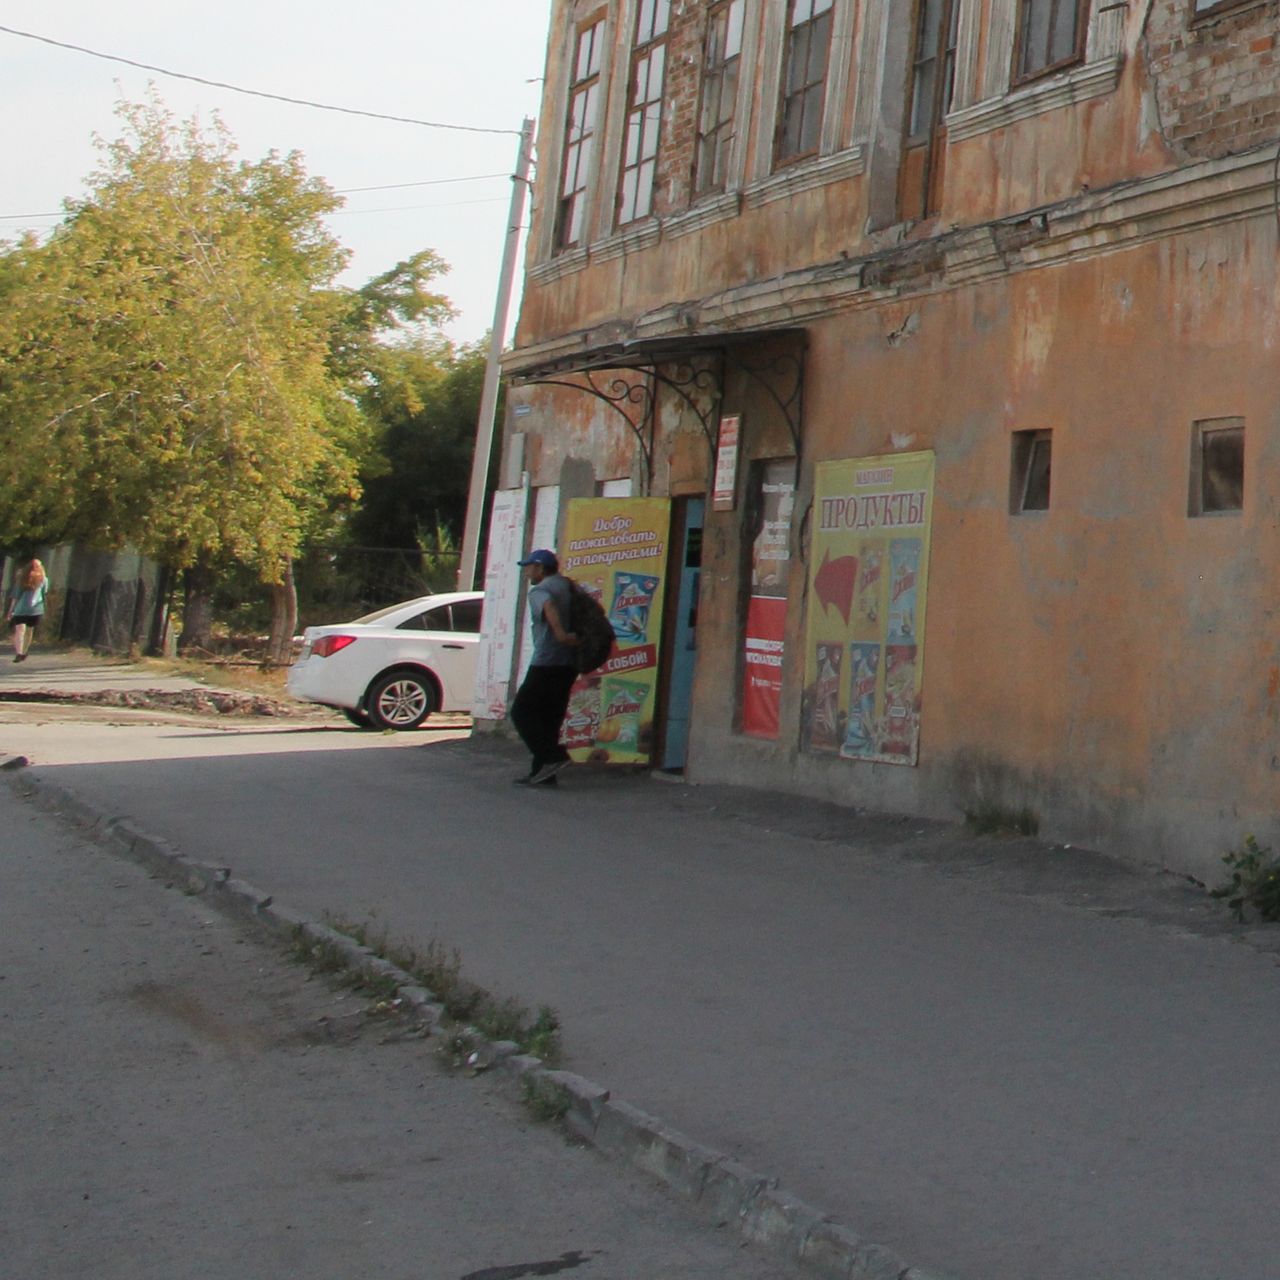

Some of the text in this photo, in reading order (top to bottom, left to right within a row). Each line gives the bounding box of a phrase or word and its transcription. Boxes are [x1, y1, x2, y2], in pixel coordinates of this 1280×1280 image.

[820, 492, 926, 530] ПРОДУКТЫ
[592, 514, 632, 532] Добро
[570, 531, 656, 551] пожаловать
[567, 543, 663, 571] за покупками!
[607, 651, 648, 670] СОБОЙ!
